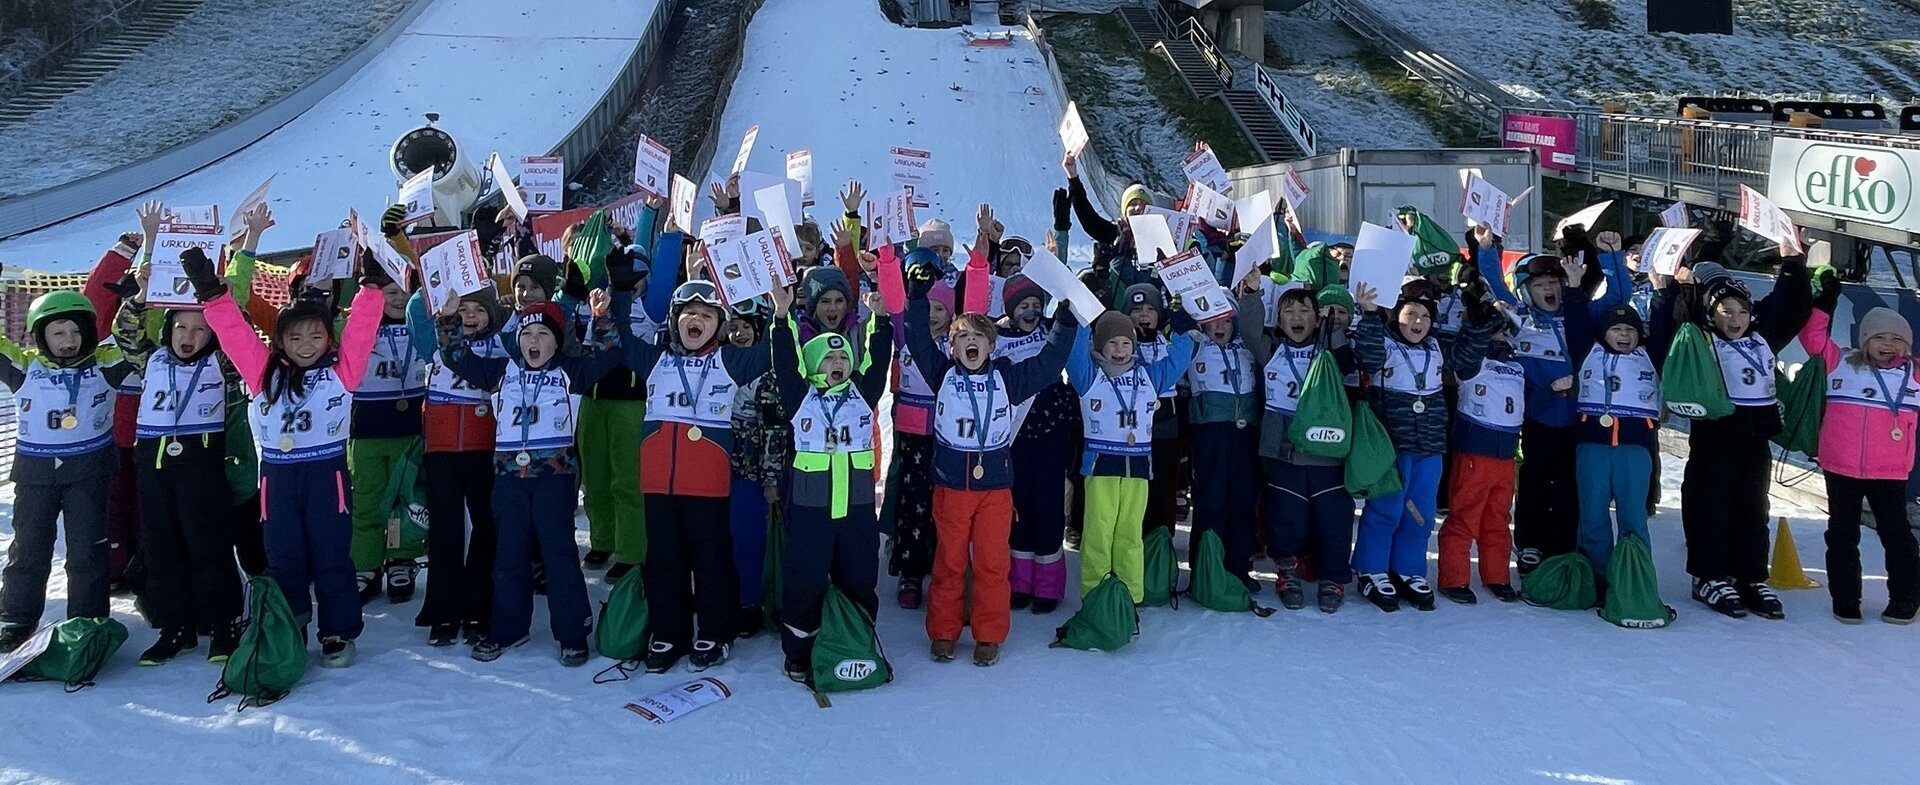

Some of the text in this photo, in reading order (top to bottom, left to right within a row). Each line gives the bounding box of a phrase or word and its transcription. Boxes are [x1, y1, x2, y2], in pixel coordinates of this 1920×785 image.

[1524, 121, 1540, 133] FANS
[1536, 134, 1556, 147] FARBE
[524, 167, 558, 175] URKUNDE
[894, 158, 927, 168] URKUNDE
[1805, 154, 1896, 214] efko
[897, 194, 907, 237] URKUNDE
[1752, 193, 1761, 229] URKUNDE
[161, 239, 215, 250] URKUNDE
[456, 240, 474, 287] URKUNDE
[757, 236, 777, 279] URKUND
[1165, 261, 1203, 281] URKUNDE
[1007, 329, 1047, 351] RIEDEL
[1742, 367, 1756, 385] 3
[665, 391, 691, 408] 10
[1505, 396, 1514, 414] 8
[280, 409, 313, 434] 23
[512, 405, 540, 427] 20
[1116, 410, 1138, 430] 14
[956, 417, 976, 438] 17
[1310, 429, 1340, 441] efko
[839, 662, 872, 678] efko
[639, 696, 675, 716] URKUNDE
